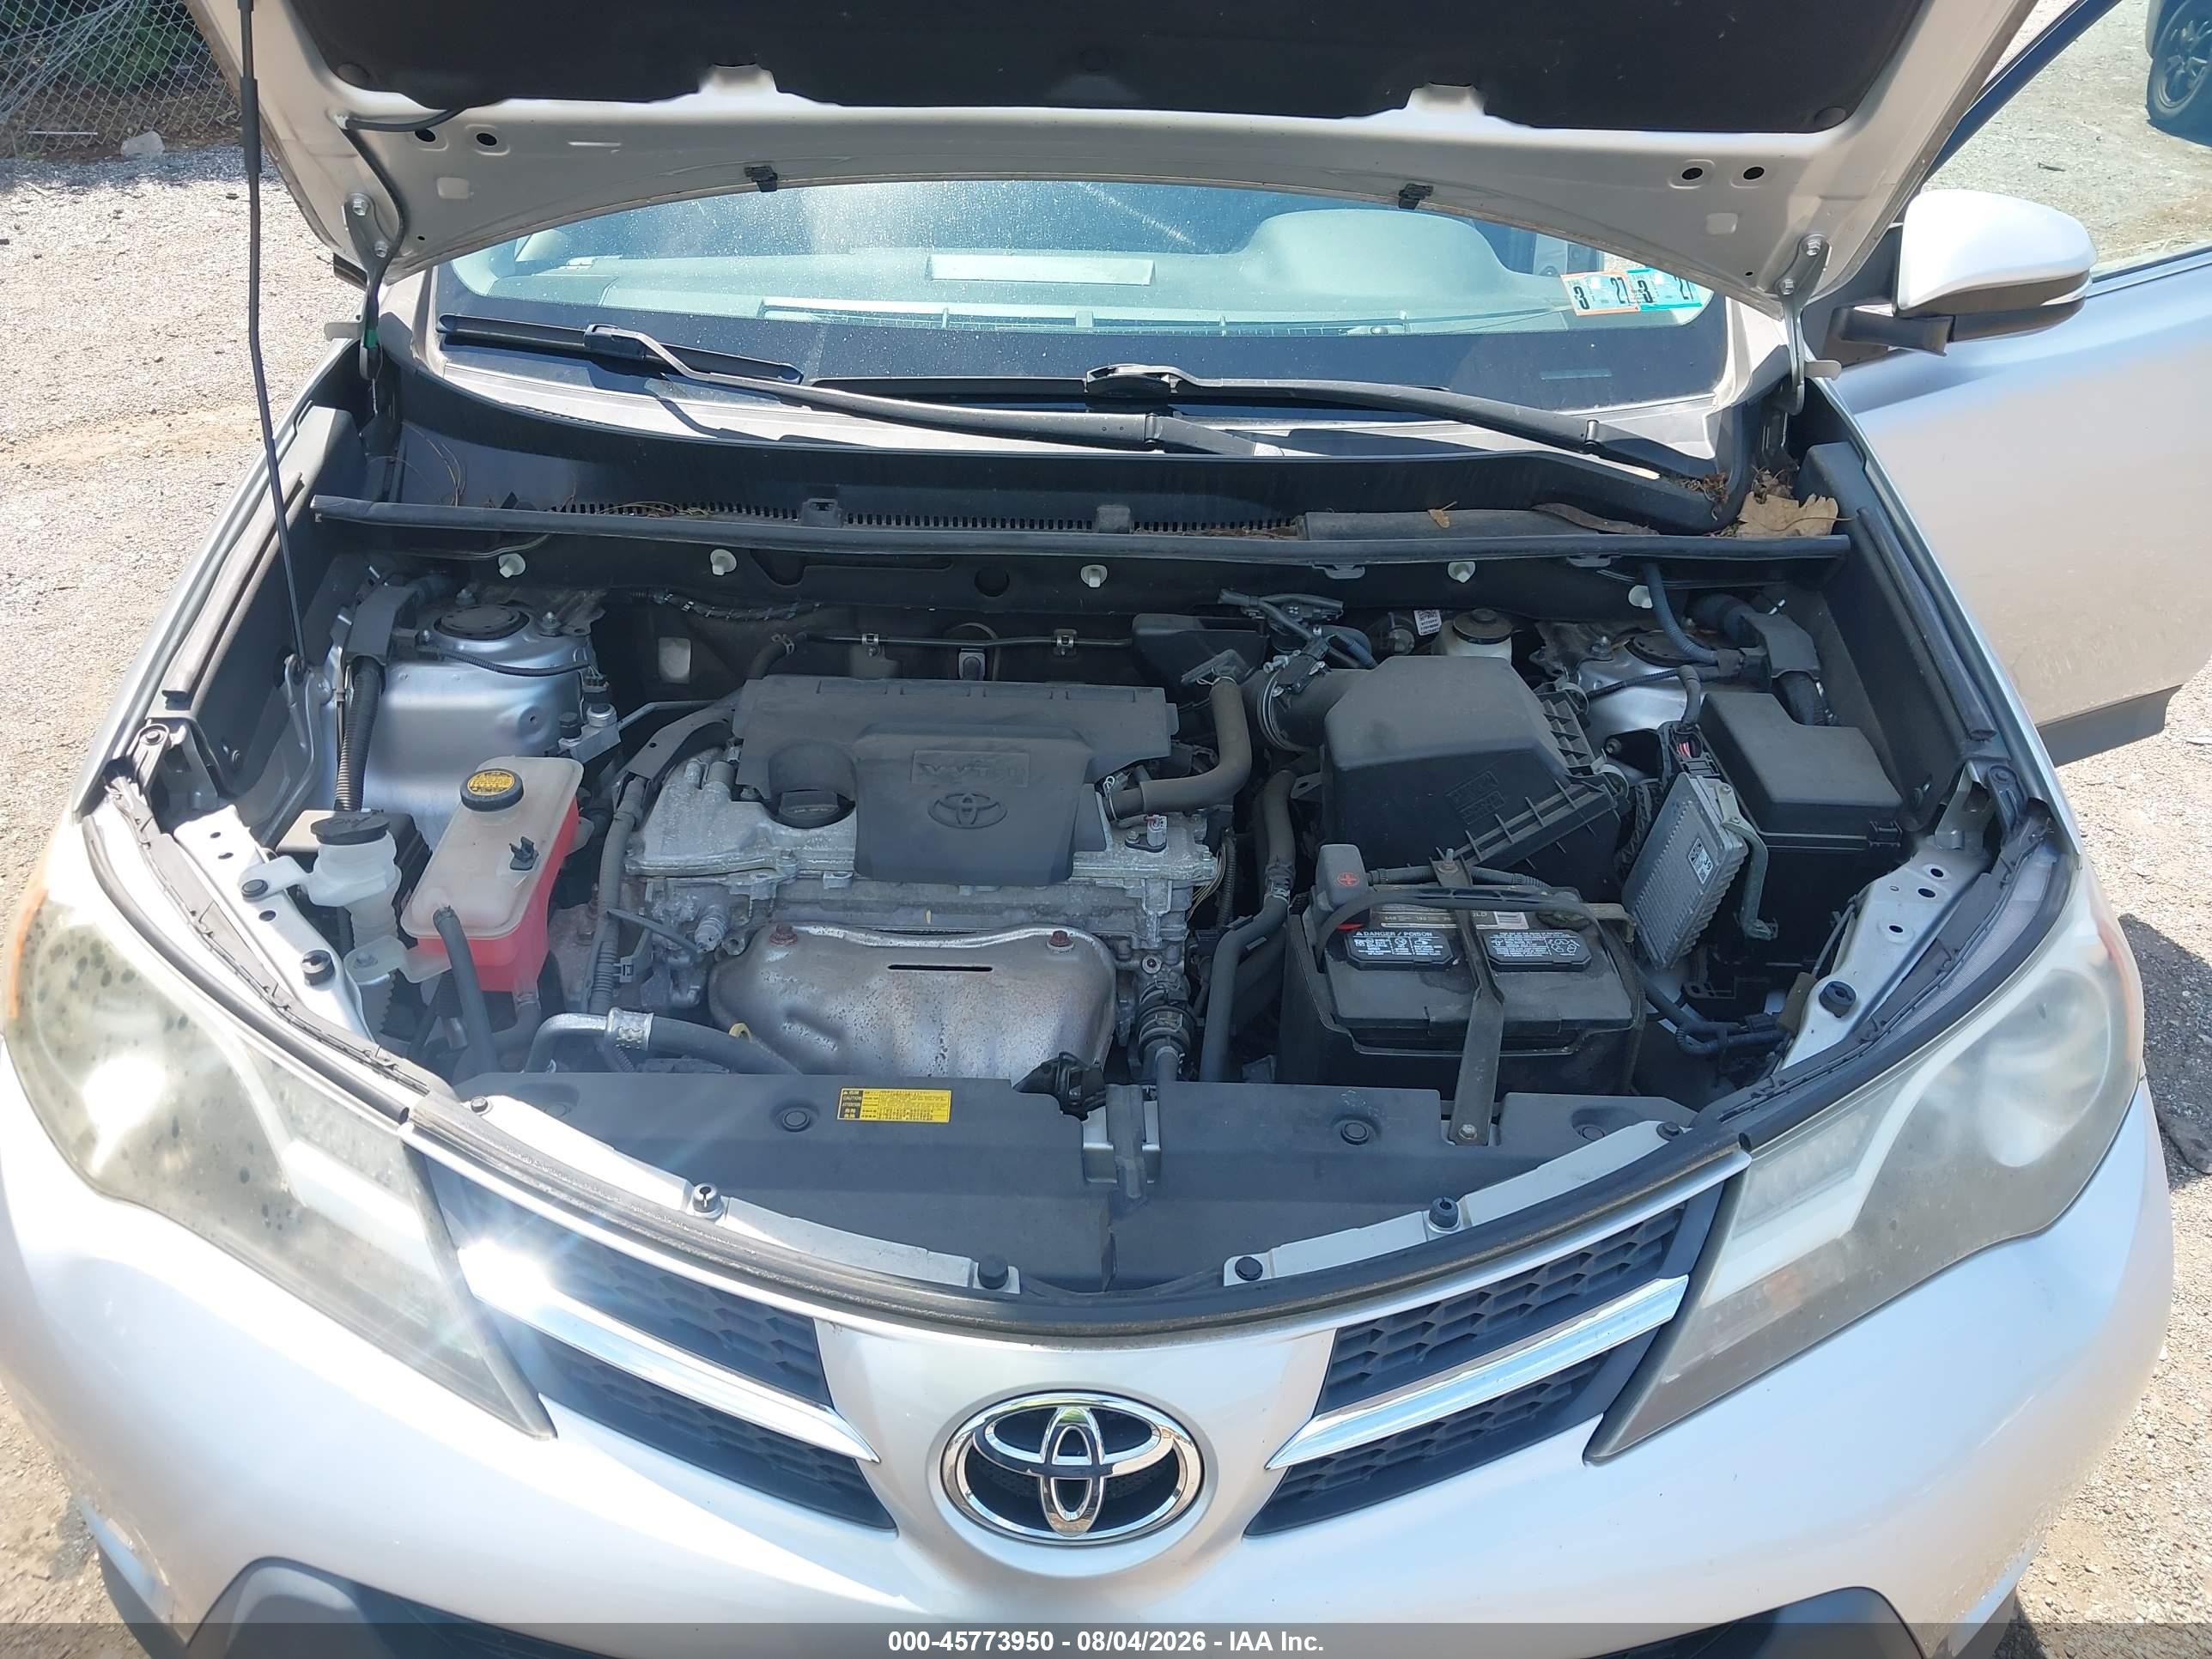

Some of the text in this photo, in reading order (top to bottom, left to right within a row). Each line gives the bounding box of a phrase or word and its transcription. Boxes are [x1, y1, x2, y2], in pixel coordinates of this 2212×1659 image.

[1573, 286, 1590, 310] 3
[1610, 276, 1632, 306] 27
[1637, 280, 1654, 303] 3
